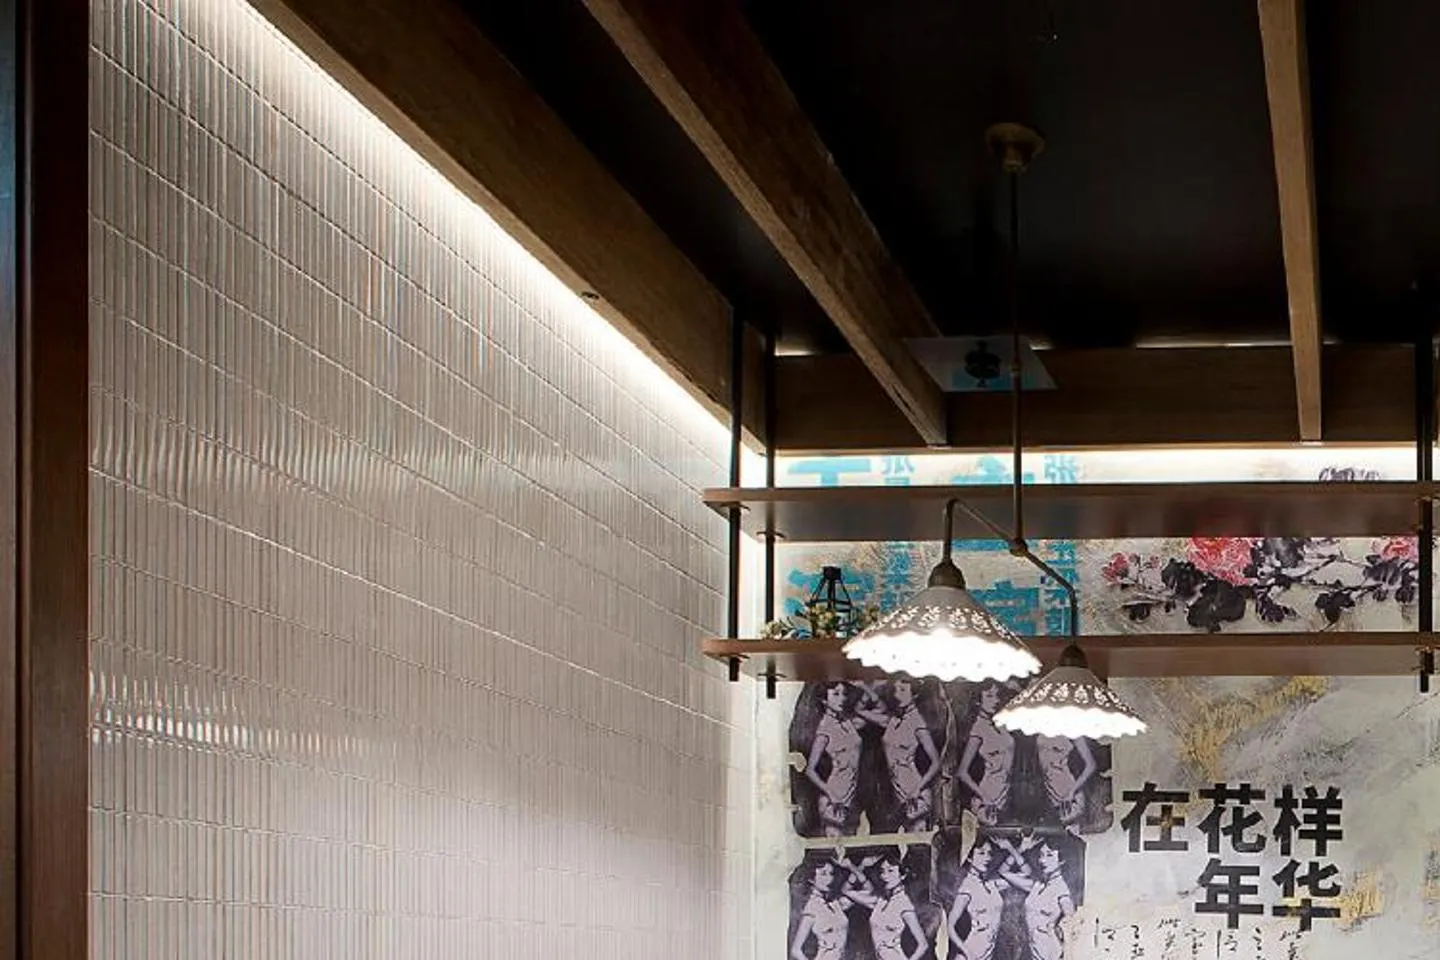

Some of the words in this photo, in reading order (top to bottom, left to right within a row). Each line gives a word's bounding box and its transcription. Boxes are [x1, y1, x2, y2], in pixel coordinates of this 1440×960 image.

[1121, 782, 1343, 858] 在花样
[1194, 860, 1342, 933] 年华
